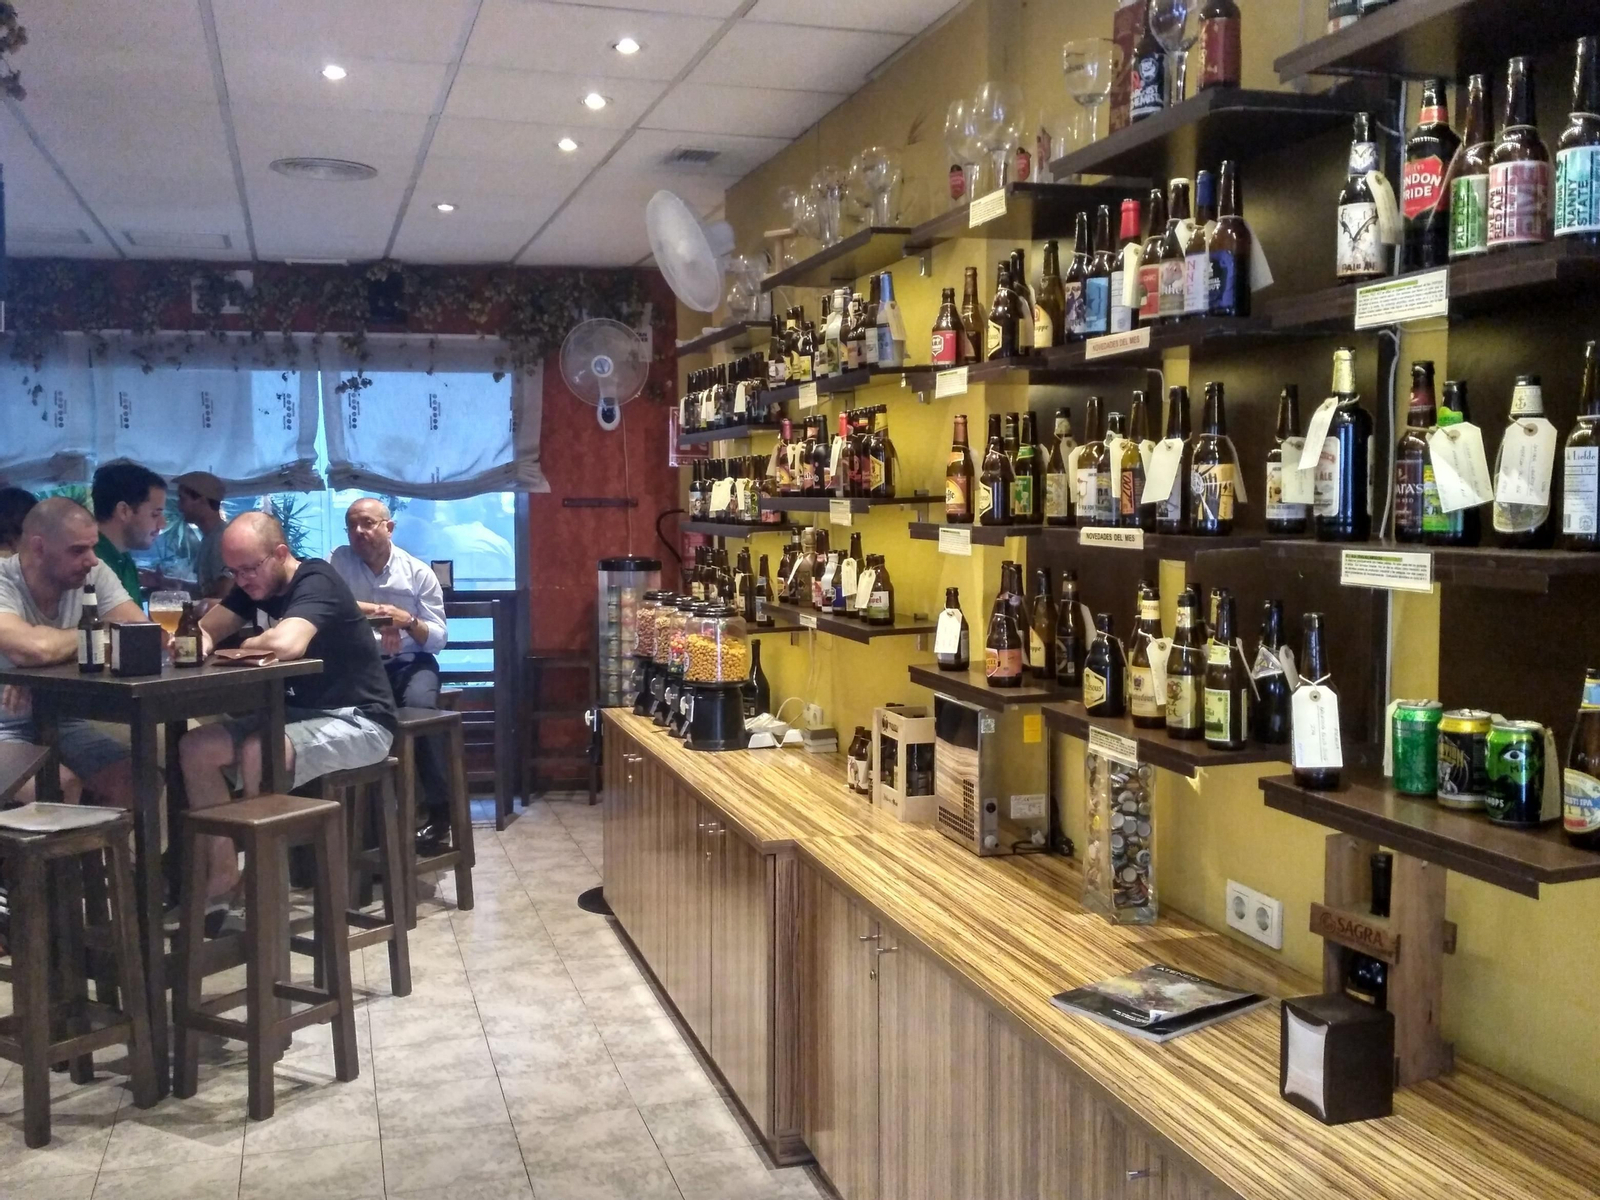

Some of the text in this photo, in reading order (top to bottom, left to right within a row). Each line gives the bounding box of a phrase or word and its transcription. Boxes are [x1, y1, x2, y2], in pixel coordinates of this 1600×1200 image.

[1494, 187, 1503, 239] RED ALE
[1566, 178, 1578, 227] NANNY
[1577, 179, 1589, 226] STATE
[1092, 335, 1140, 352] NOVEDADES DEL MES
[1086, 532, 1136, 542] NOVEDADES DEL MES
[1337, 917, 1384, 948] SAGRA
[1156, 966, 1201, 983] ATENEO
